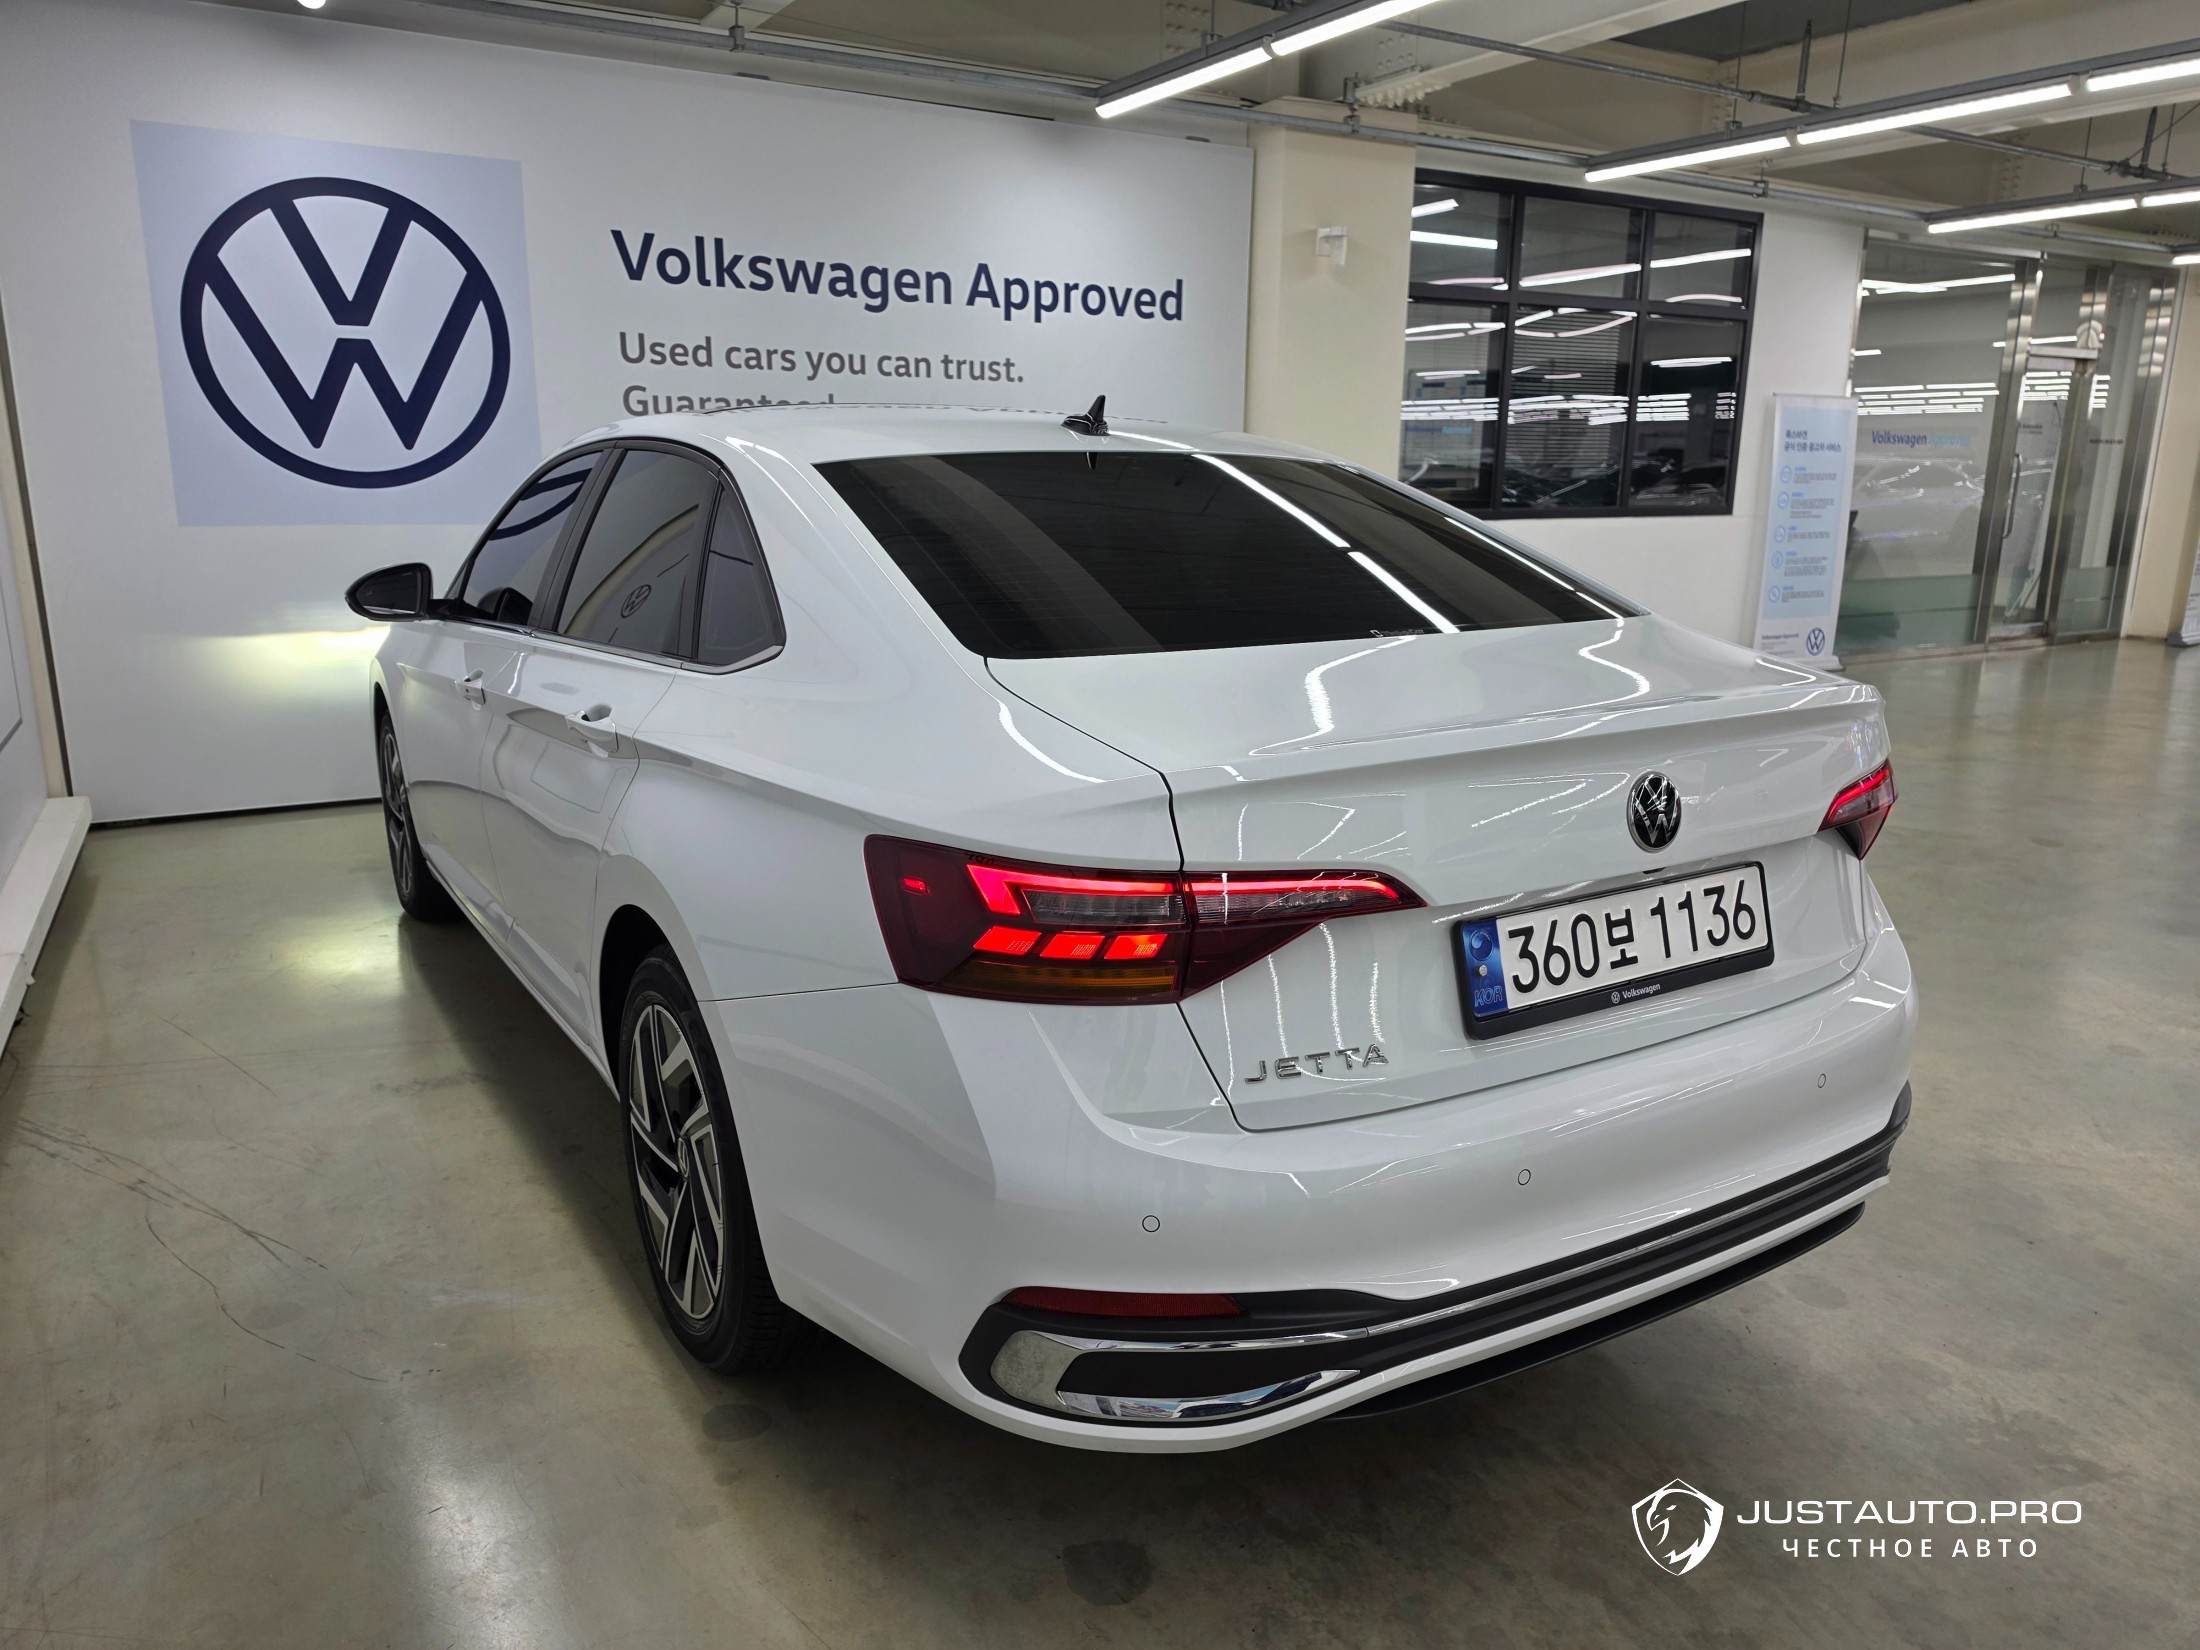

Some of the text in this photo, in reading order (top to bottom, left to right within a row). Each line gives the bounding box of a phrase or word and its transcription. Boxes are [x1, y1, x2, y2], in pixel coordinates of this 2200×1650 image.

[610, 229, 1184, 324] Volkswagen Approved
[181, 177, 511, 489] VW
[618, 331, 1024, 384] Used cars you can trust.
[1872, 430, 1928, 448] Volkswagen
[1507, 879, 1756, 994] 360보 1136
[1473, 985, 1504, 1008] KOR
[1622, 983, 1661, 999] Volkswagen
[1244, 1043, 1389, 1084] JETTA
